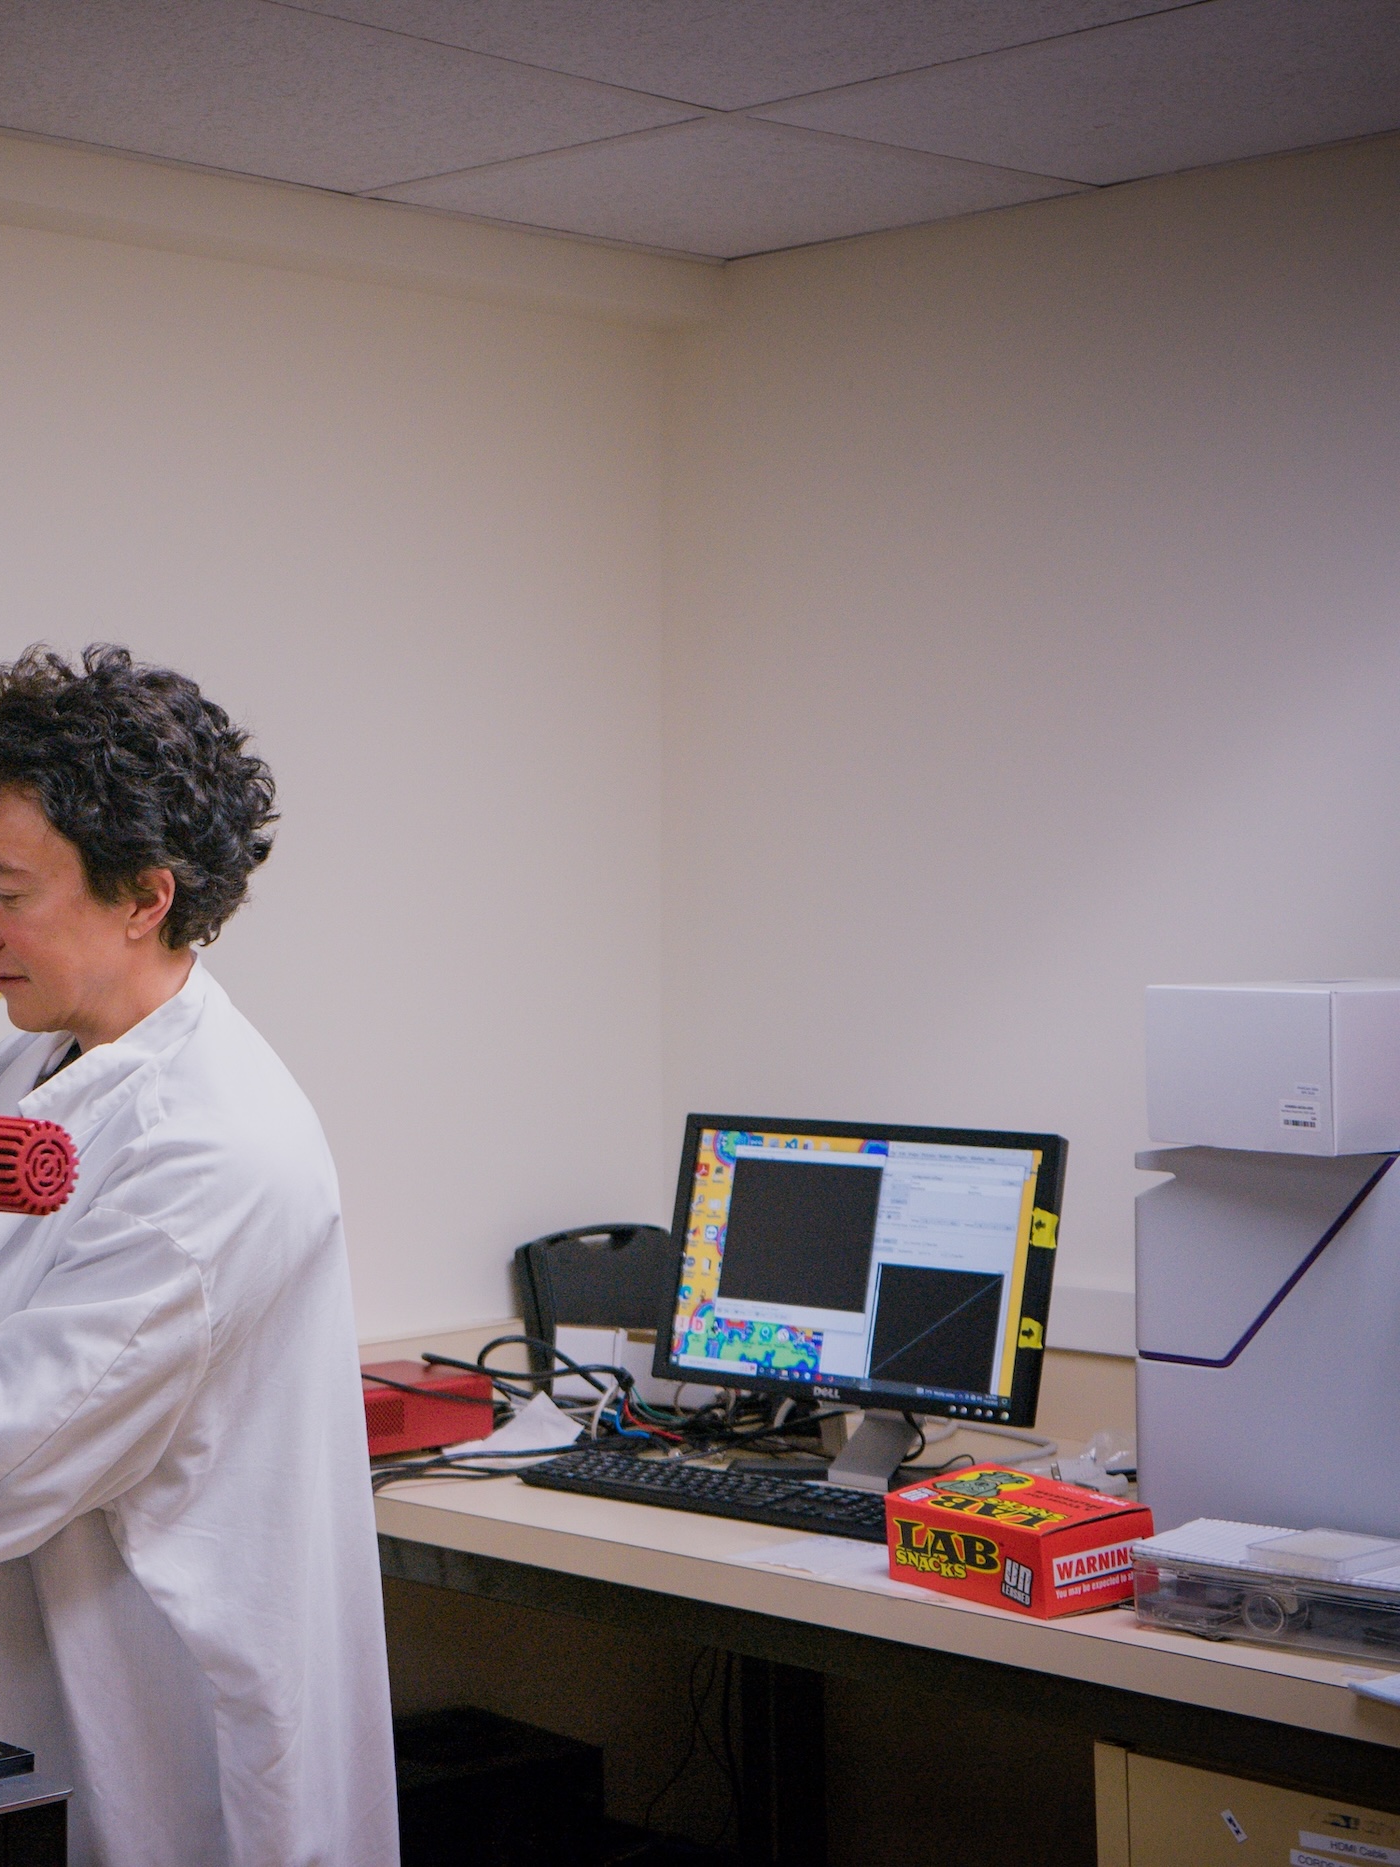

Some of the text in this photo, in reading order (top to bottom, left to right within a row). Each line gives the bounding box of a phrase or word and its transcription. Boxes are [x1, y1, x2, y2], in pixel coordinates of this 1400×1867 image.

[813, 1386, 840, 1400] DELL
[928, 1494, 1046, 1530] LAB
[893, 1518, 1001, 1574] LAB
[895, 1546, 968, 1579] SNACKS
[1001, 1582, 1031, 1606] LEASHED
[1055, 1589, 1068, 1600] You
[1068, 1585, 1082, 1597] may
[1082, 1582, 1091, 1593] be
[1091, 1574, 1120, 1591] expected
[1120, 1573, 1127, 1584] to
[1329, 1840, 1389, 1860] HDMI Cable
